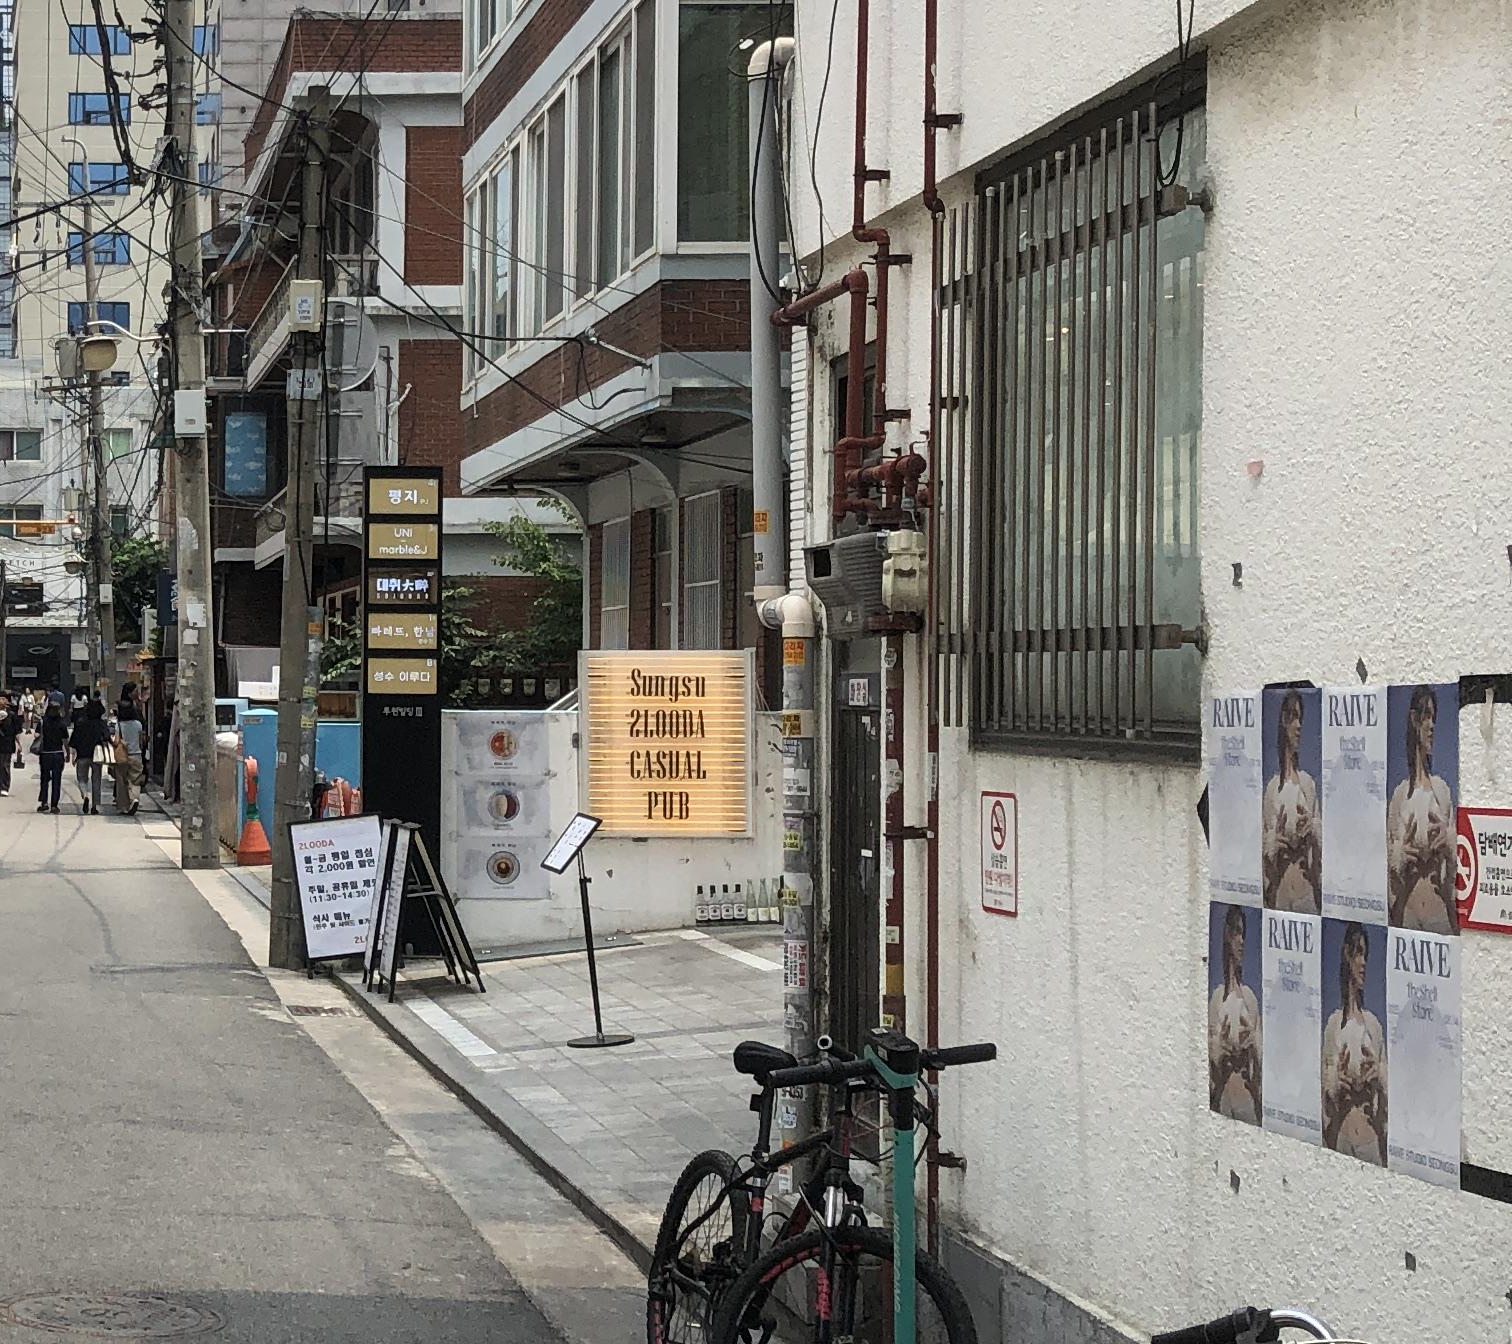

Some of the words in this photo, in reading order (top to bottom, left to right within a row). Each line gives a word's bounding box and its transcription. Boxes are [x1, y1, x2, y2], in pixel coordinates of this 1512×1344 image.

[388, 489, 418, 505] 평지
[394, 528, 413, 537] UNI
[379, 545, 428, 554] marble&J
[374, 671, 394, 682] 성수
[399, 671, 431, 682] 이루다
[630, 668, 706, 703] Sungsu
[1213, 697, 1256, 728] RAIVE
[1328, 693, 1378, 727] RAIVE
[629, 709, 705, 739] 2LOODA
[630, 750, 707, 780] CASUAL
[647, 791, 690, 820] PUB
[299, 840, 334, 850] 2LOODA
[331, 850, 349, 861] 평일
[305, 866, 313, 874] 각
[313, 913, 329, 923] 식사
[1268, 917, 1313, 954] RAIVE
[1394, 936, 1451, 978] RAIVE
